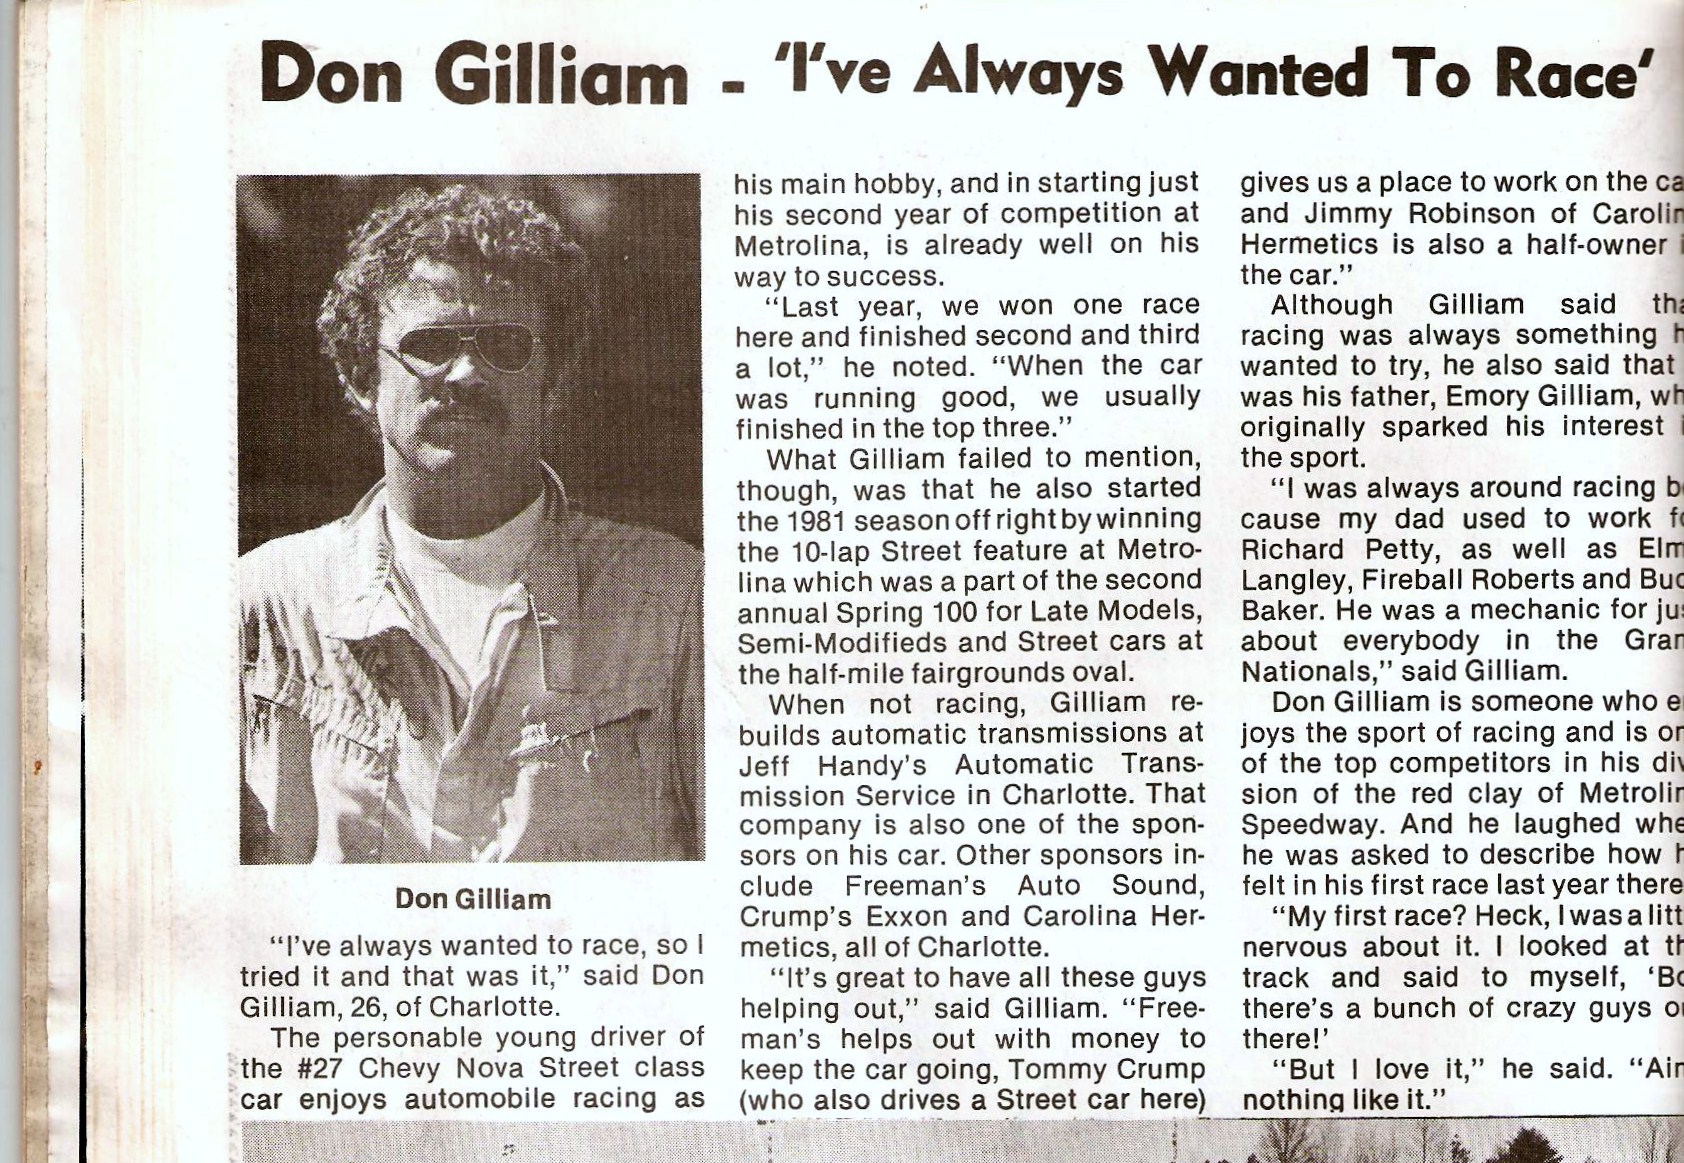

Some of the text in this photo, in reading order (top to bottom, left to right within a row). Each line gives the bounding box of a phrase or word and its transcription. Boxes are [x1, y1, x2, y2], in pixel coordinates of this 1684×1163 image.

[262, 40, 401, 103] Don
[436, 40, 687, 105] Gilliam
[914, 42, 1123, 107] Always
[1148, 43, 1368, 97] Wanted
[1392, 47, 1470, 97] To
[734, 170, 1199, 199] his main hobby, and in starting just
[735, 231, 1199, 260] Metrolina, is already well on his
[1241, 232, 1668, 256] Hermetics is also a half-owner
[1240, 263, 1282, 286] the
[736, 322, 1200, 348] here and finished second and third
[1240, 352, 1675, 381] wanted to try, he also said that
[766, 445, 1201, 471] What Gilliam failed to mention,
[1240, 446, 1366, 473] the sport.
[1242, 537, 1344, 561] Richard
[1366, 538, 1441, 565] Petty,
[1461, 542, 1492, 560] as
[1512, 536, 1565, 560] well
[1587, 541, 1617, 559] as
[737, 597, 1202, 628] annual Spring 100 for Late Models,
[738, 629, 1204, 655] Semi-Modifieds and Street cars at
[1401, 658, 1457, 682] said
[1465, 658, 1568, 682] Gilliam.
[1273, 689, 1658, 713] Don Gilliam is someone who
[739, 721, 1204, 747] builds automatic transmissions at
[740, 781, 1206, 808] mission Service in Charlotte. That
[396, 887, 551, 911] Don Gilliam
[740, 873, 1205, 900] clude Freeman's Auto Sound,
[1242, 874, 1286, 896] felt
[1294, 873, 1316, 896] in
[1325, 873, 1364, 896] his
[1370, 873, 1425, 896] first
[1432, 878, 1489, 896] race
[1497, 873, 1545, 896] last
[1552, 877, 1610, 900] year
[741, 935, 1049, 962] metics, all of Charlotte.
[240, 995, 560, 1022] Gilliam, 26, of Charlotte.
[270, 1024, 705, 1053] The personable young driver of
[1242, 1027, 1328, 1050] there!'
[240, 1055, 705, 1084] the #27 Chevy Nova Street class
[741, 1057, 1206, 1085] keep the car going, Tommy Crump
[240, 1086, 705, 1116] car enjoys automobile racing as
[1243, 1088, 1345, 1113] nothing
[1353, 1088, 1399, 1111] like
